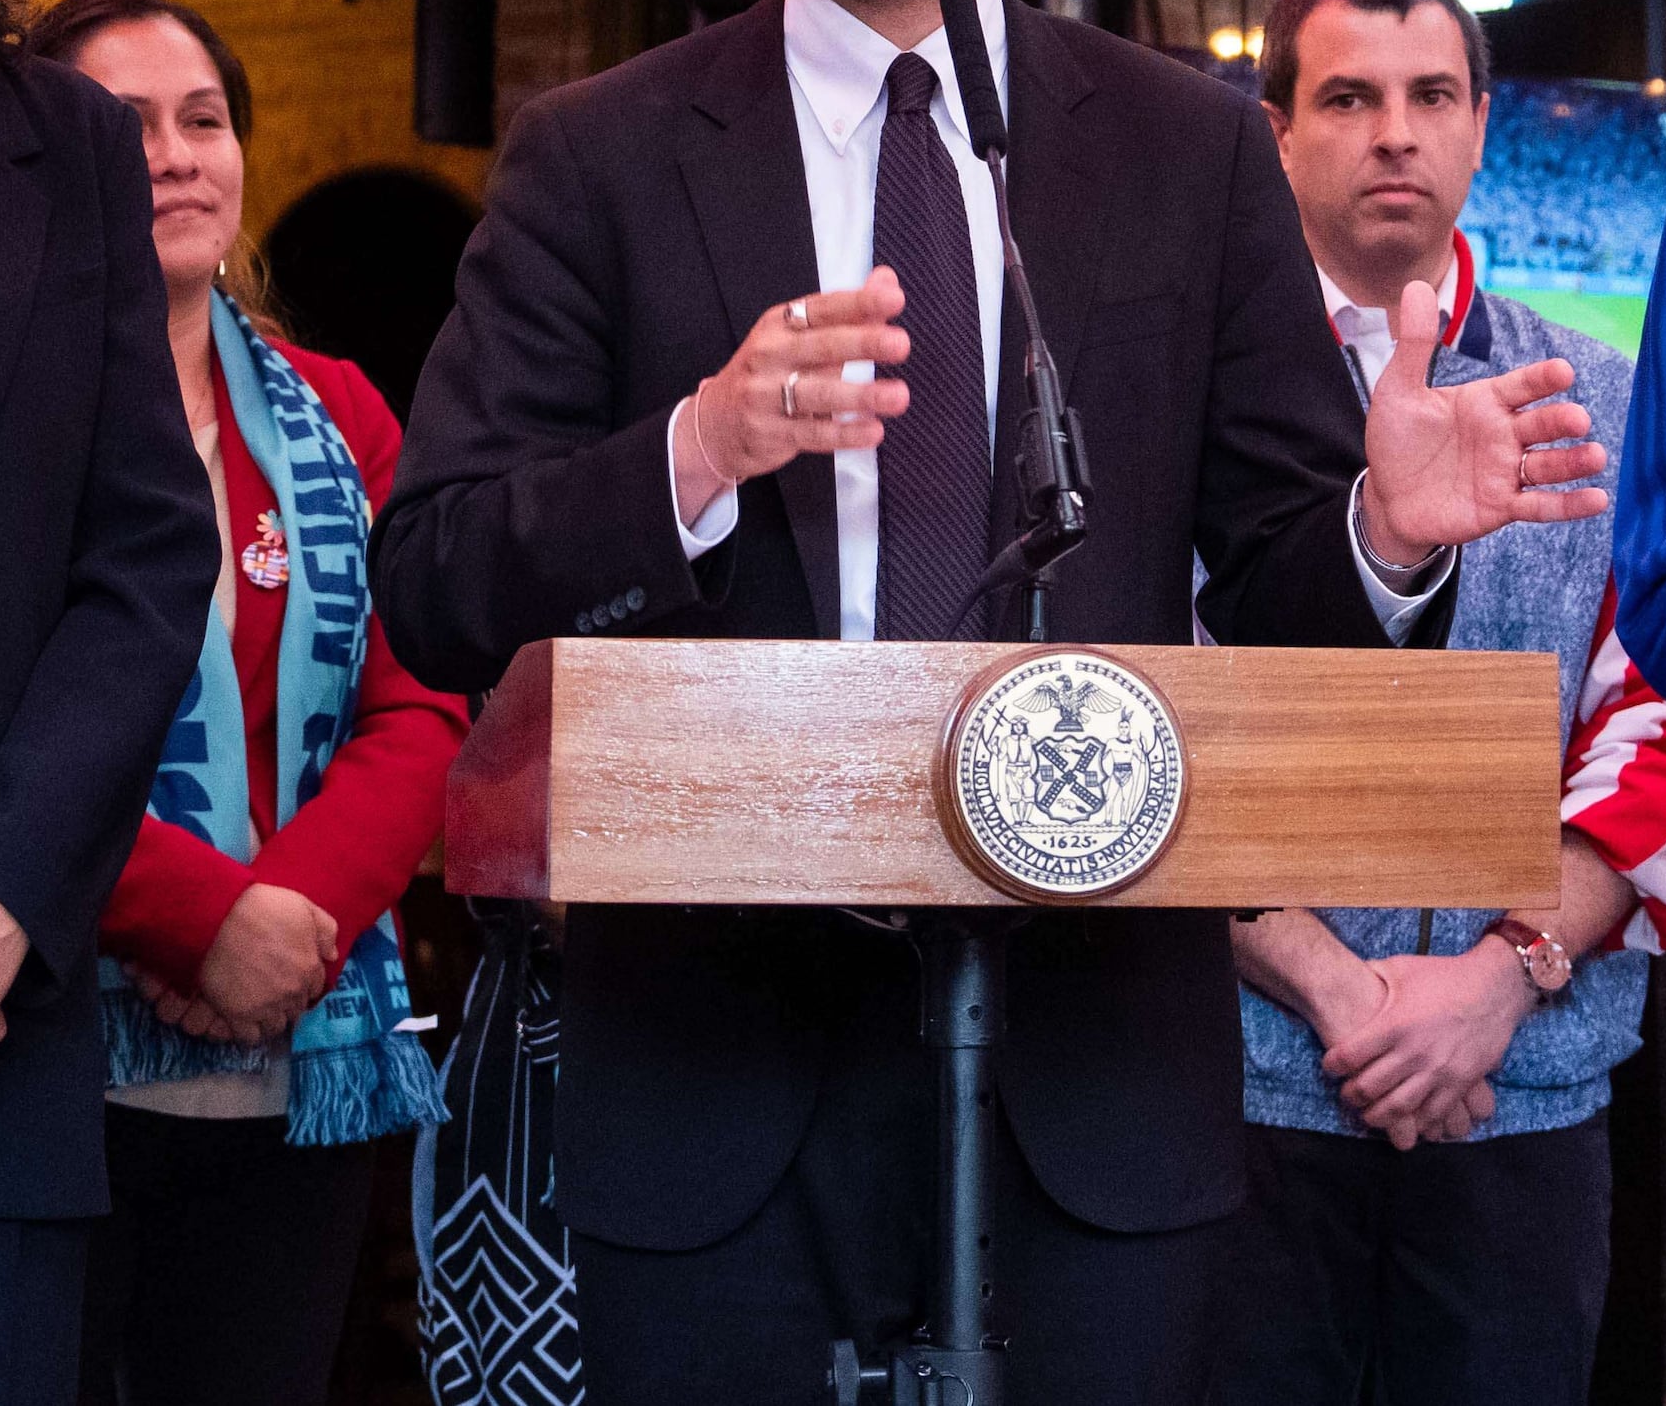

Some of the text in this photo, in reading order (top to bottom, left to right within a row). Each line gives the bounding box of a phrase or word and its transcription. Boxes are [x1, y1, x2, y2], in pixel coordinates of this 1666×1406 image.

[1004, 837, 1099, 875] CIVITATIS
[1101, 829, 1144, 863] NOVI
[1134, 760, 1166, 830] EBORACI
[1049, 835, 1092, 849] 1625
